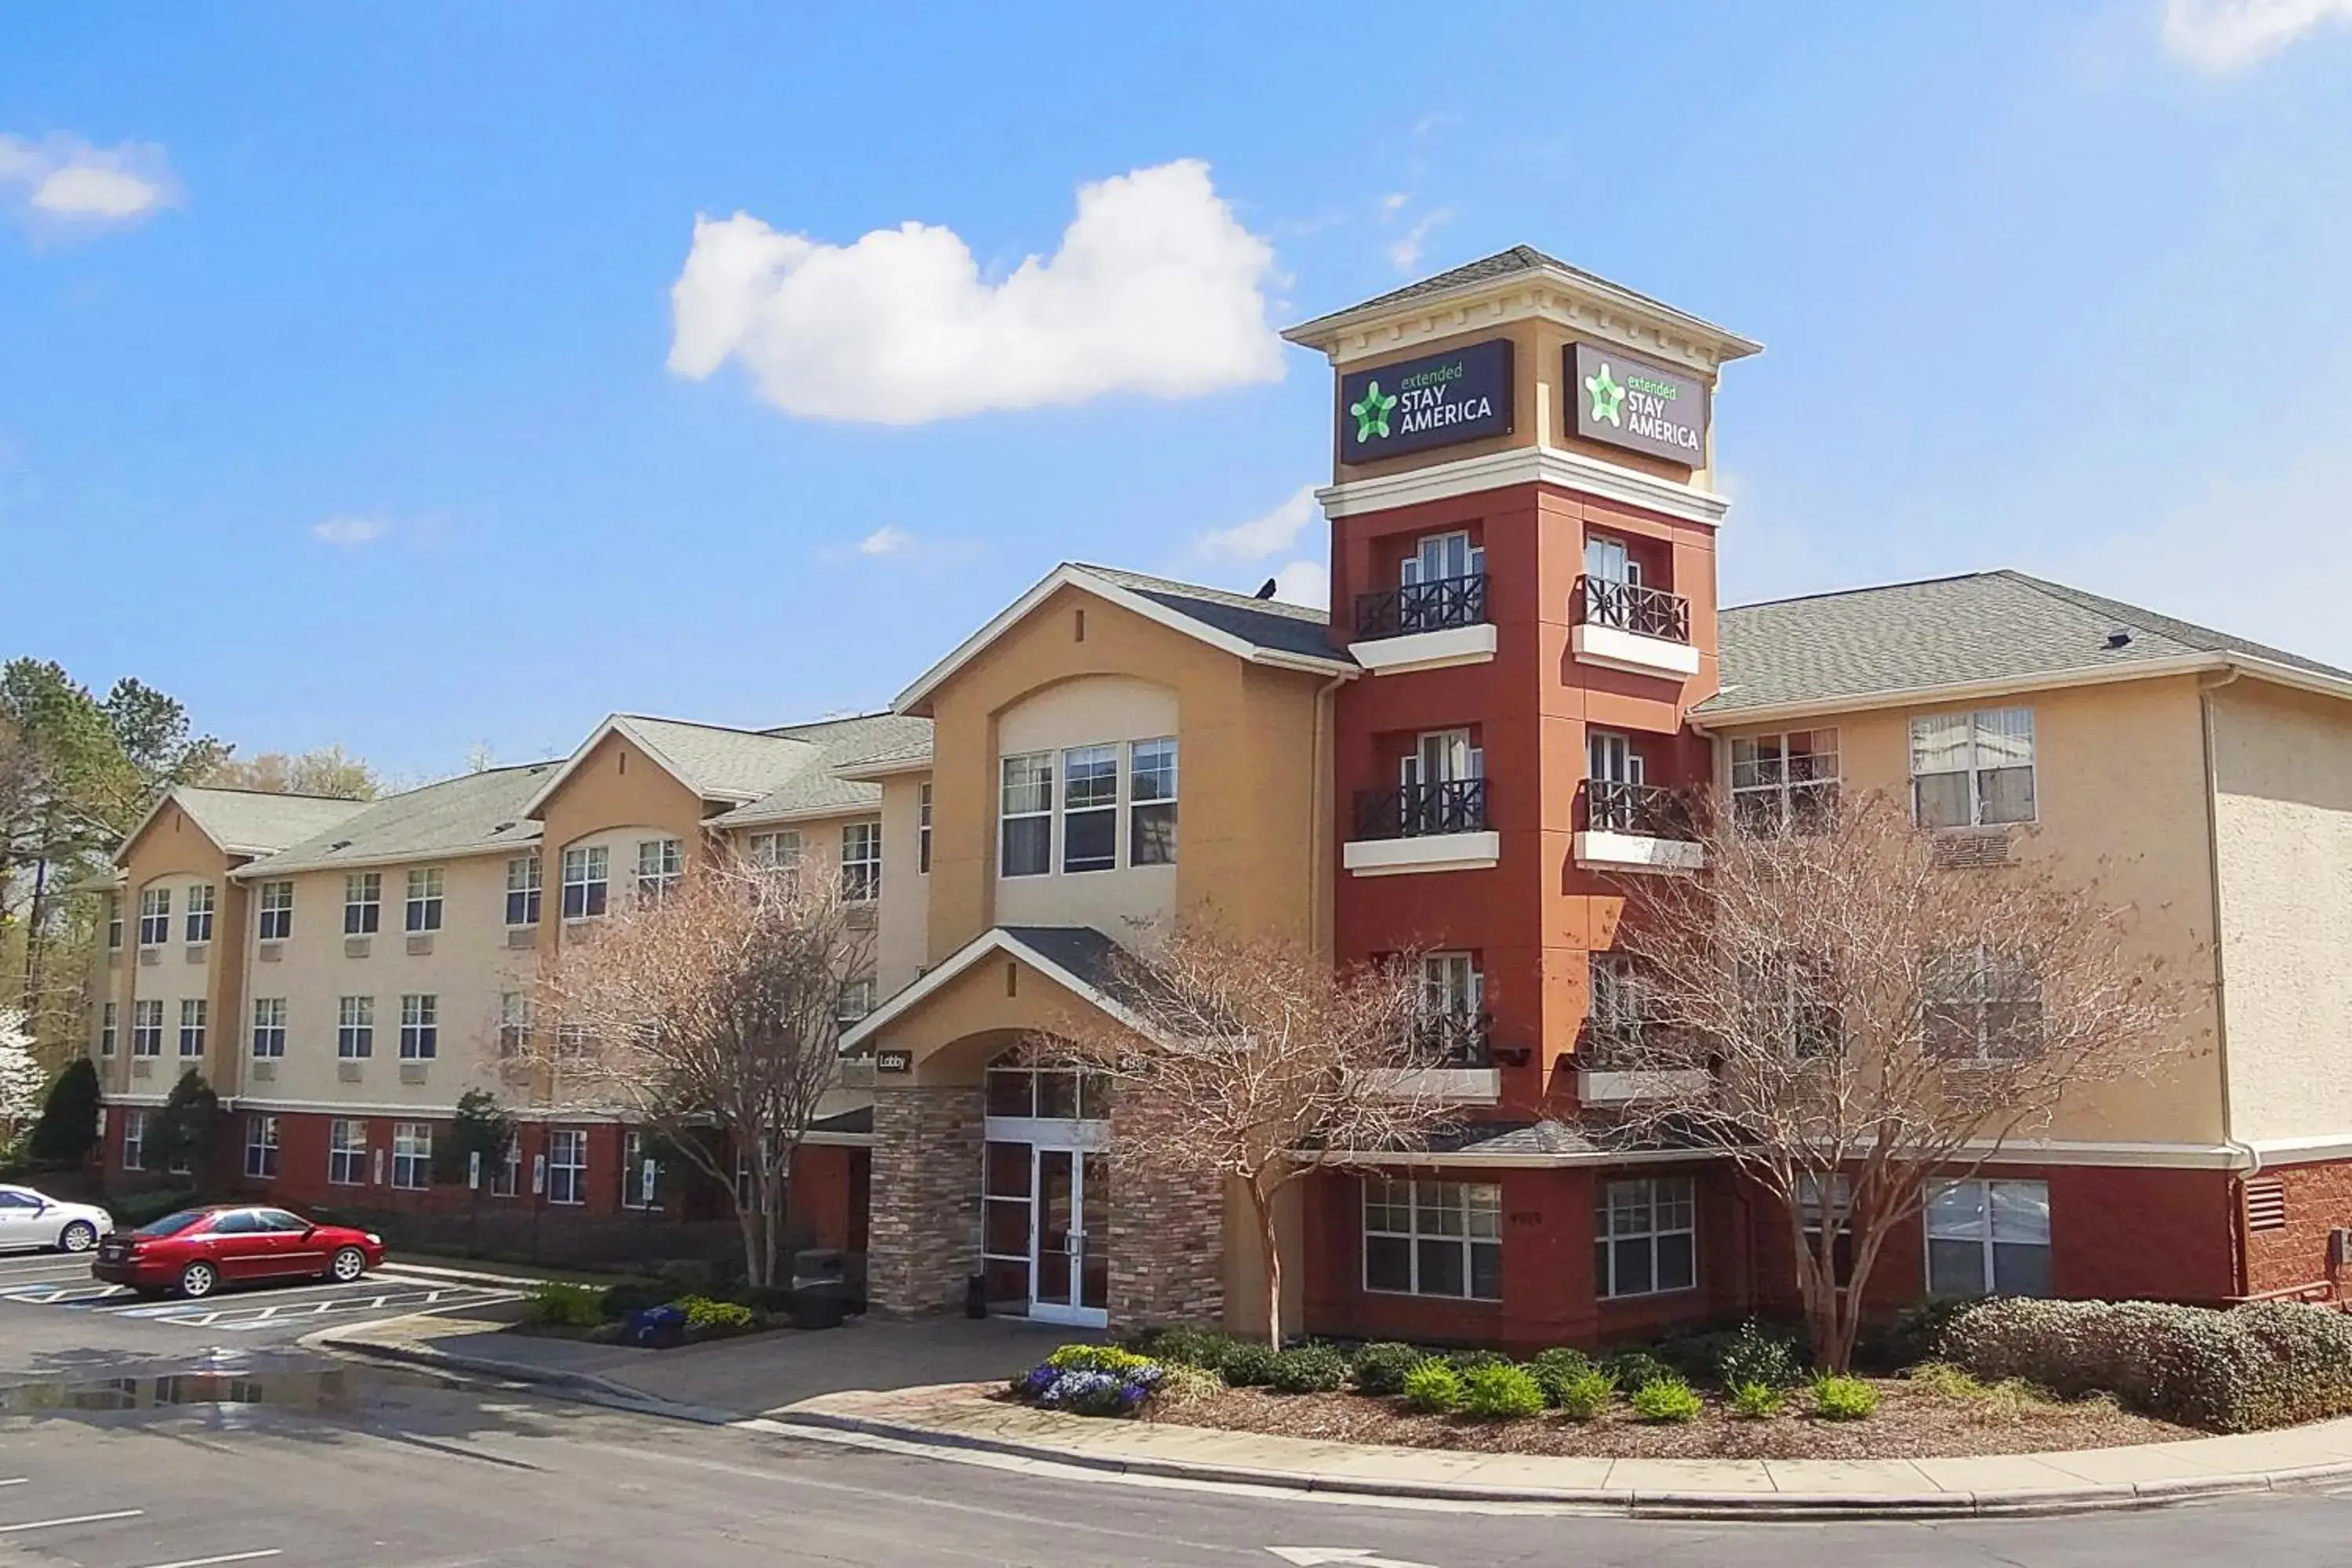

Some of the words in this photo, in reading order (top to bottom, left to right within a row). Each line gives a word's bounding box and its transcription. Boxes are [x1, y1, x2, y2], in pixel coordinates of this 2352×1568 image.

[1401, 361, 1462, 390] extended
[1628, 376, 1676, 400] extended
[1401, 383, 1446, 412] STAY
[1628, 390, 1664, 418] STAY
[1400, 397, 1491, 434] AMERICA
[1628, 413, 1699, 450] AMERICA
[879, 1054, 905, 1069] Lobby
